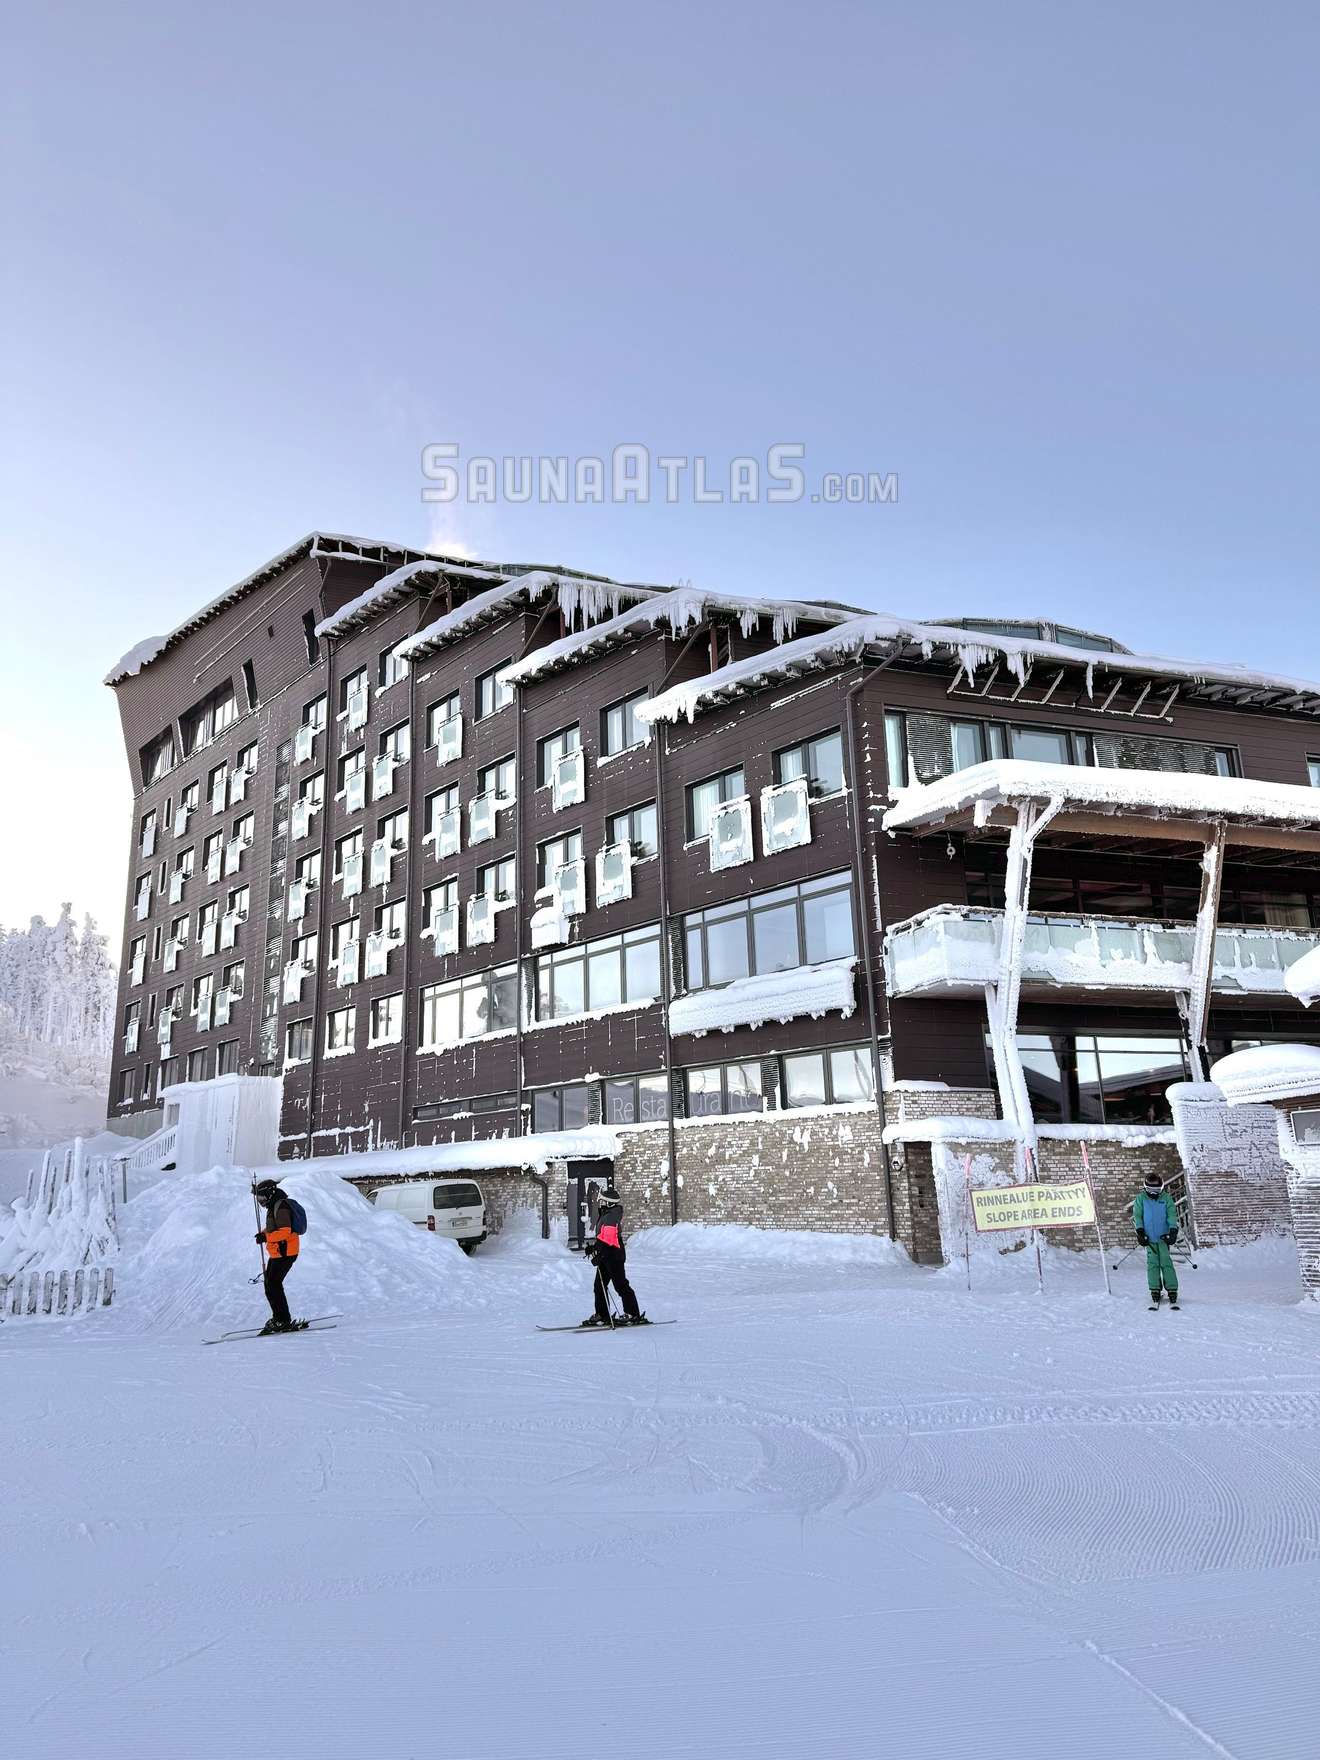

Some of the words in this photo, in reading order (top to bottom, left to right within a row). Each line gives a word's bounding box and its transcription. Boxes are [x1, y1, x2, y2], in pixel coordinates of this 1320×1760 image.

[976, 1191, 1035, 1207] RINNEALUE
[1038, 1187, 1086, 1201] PÄÄTTYY
[986, 1210, 1019, 1223] SLOPE
[1021, 1208, 1047, 1220] AREA
[1051, 1205, 1083, 1218] ENDS
